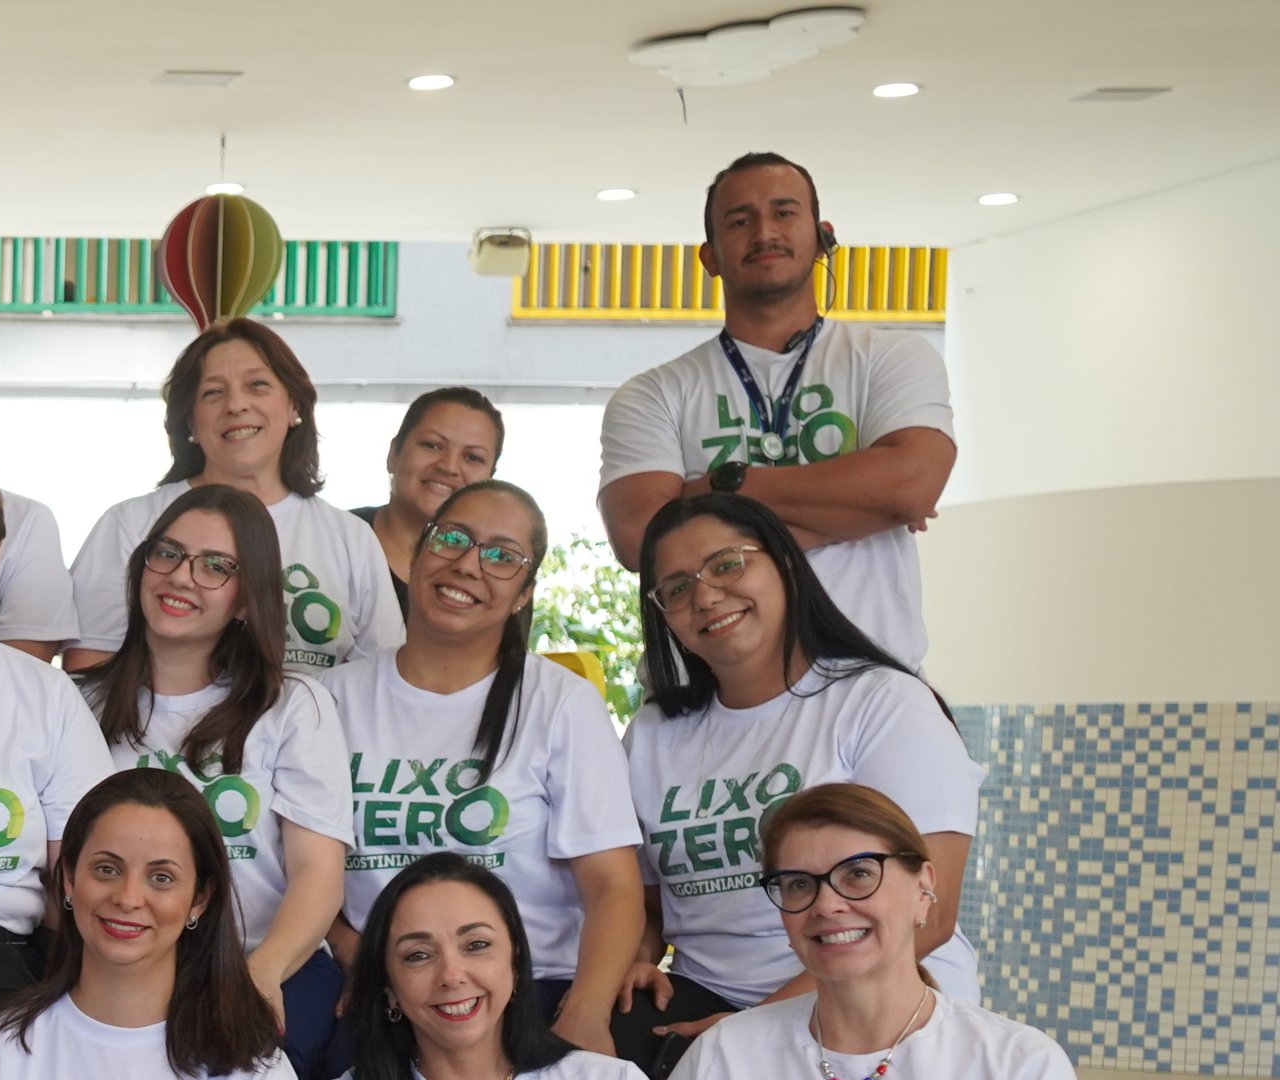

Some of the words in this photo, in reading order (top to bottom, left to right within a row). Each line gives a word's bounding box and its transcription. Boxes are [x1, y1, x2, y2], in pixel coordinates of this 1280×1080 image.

[350, 752, 487, 796] LIXO
[660, 763, 802, 824] LIXO
[354, 785, 510, 847] ERO
[672, 874, 755, 897] AGOSTINIANO
